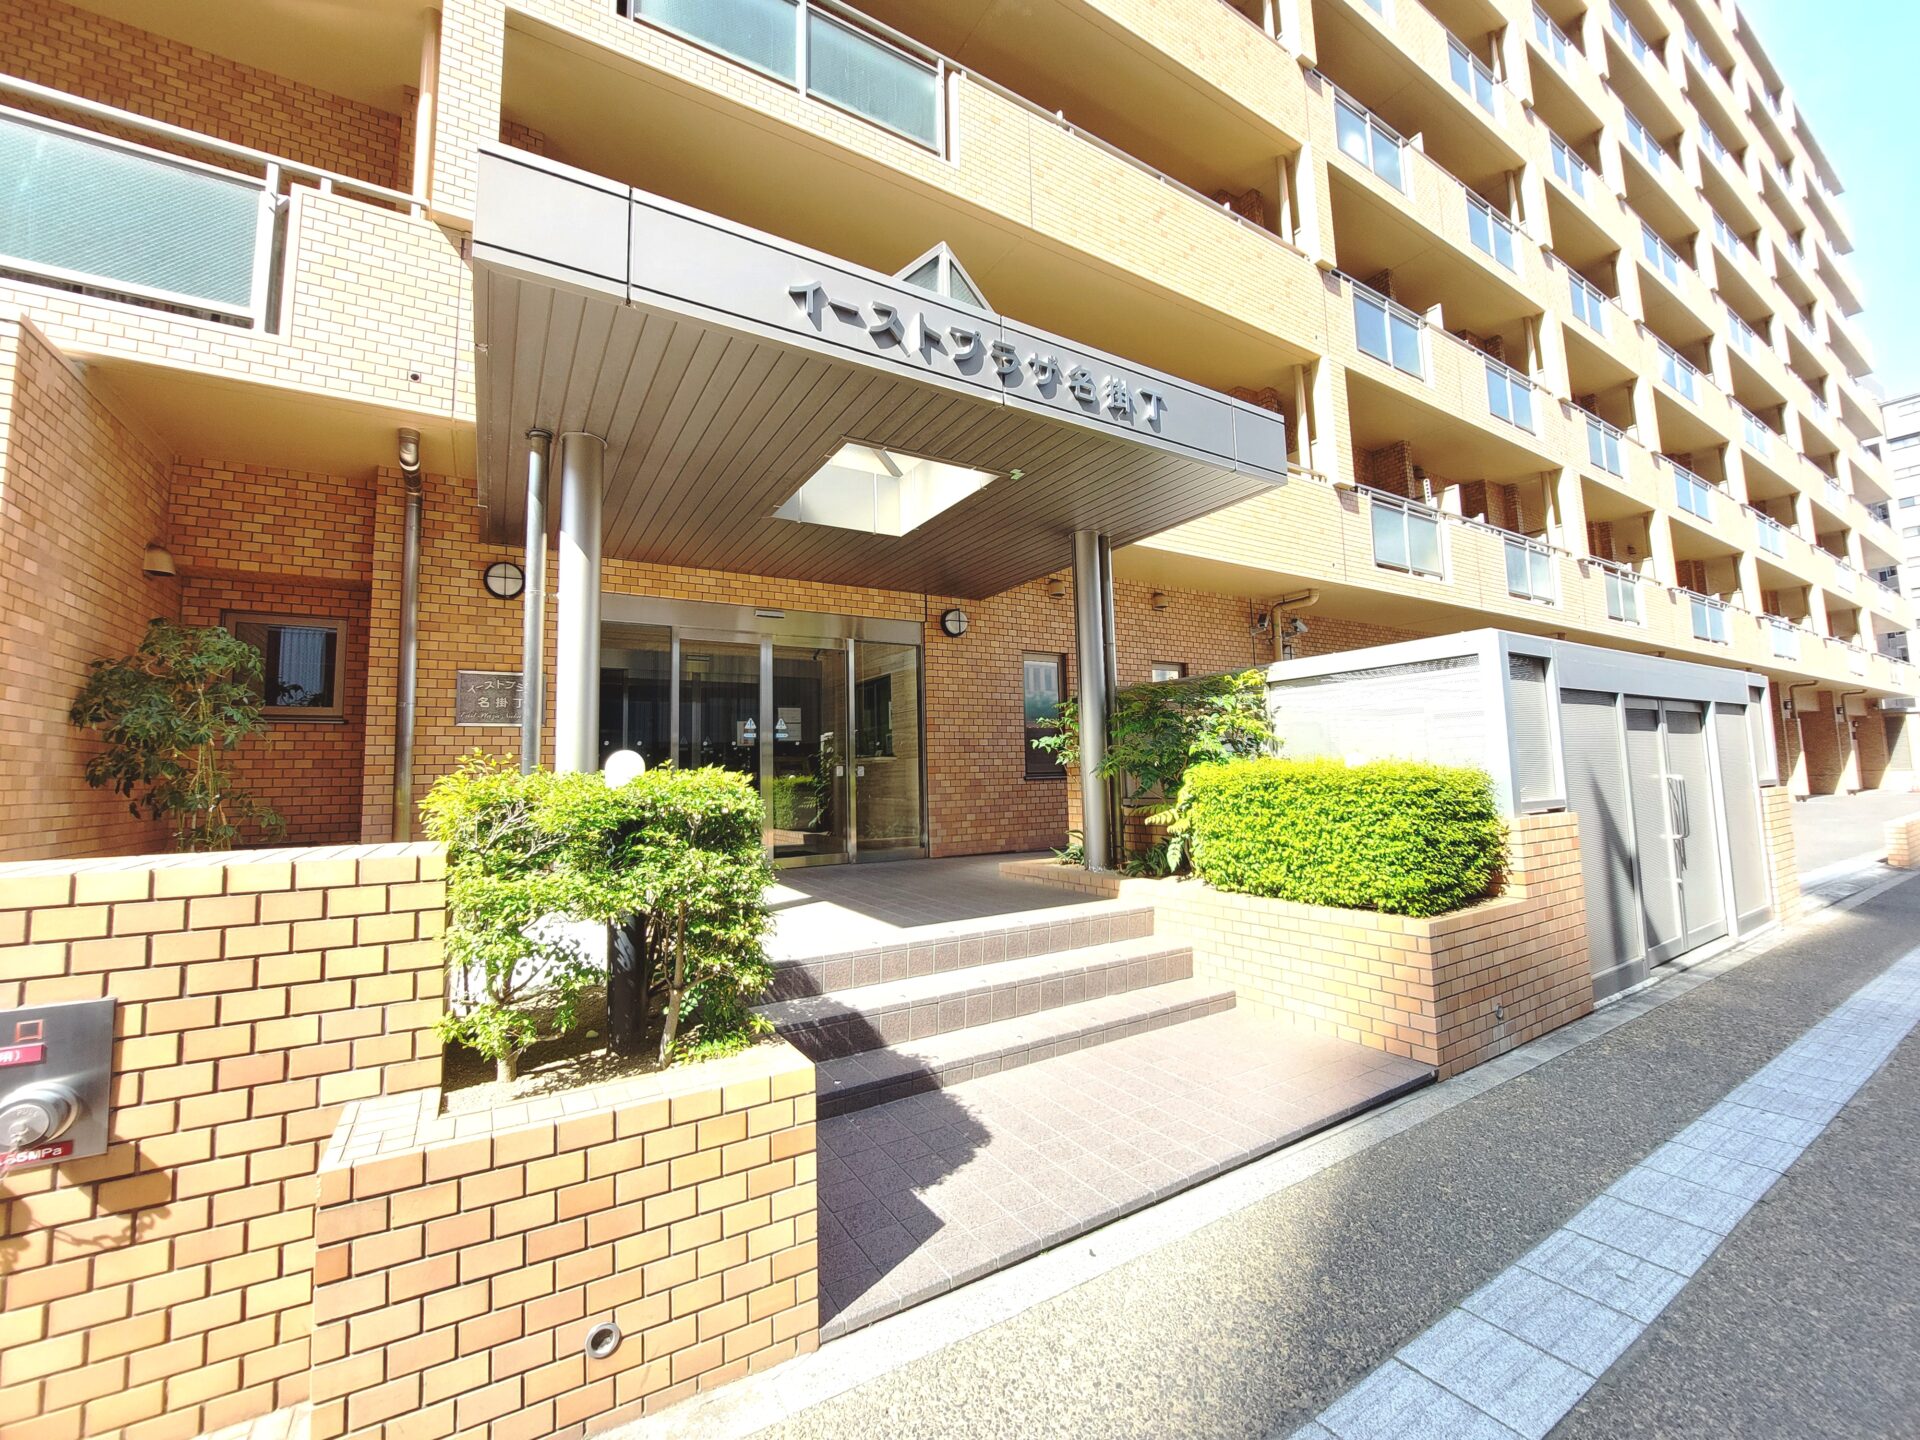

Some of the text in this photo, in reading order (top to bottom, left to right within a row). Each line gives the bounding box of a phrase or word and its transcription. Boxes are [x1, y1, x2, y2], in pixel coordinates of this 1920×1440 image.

[788, 280, 1164, 424] イーストプラザ名掛丁
